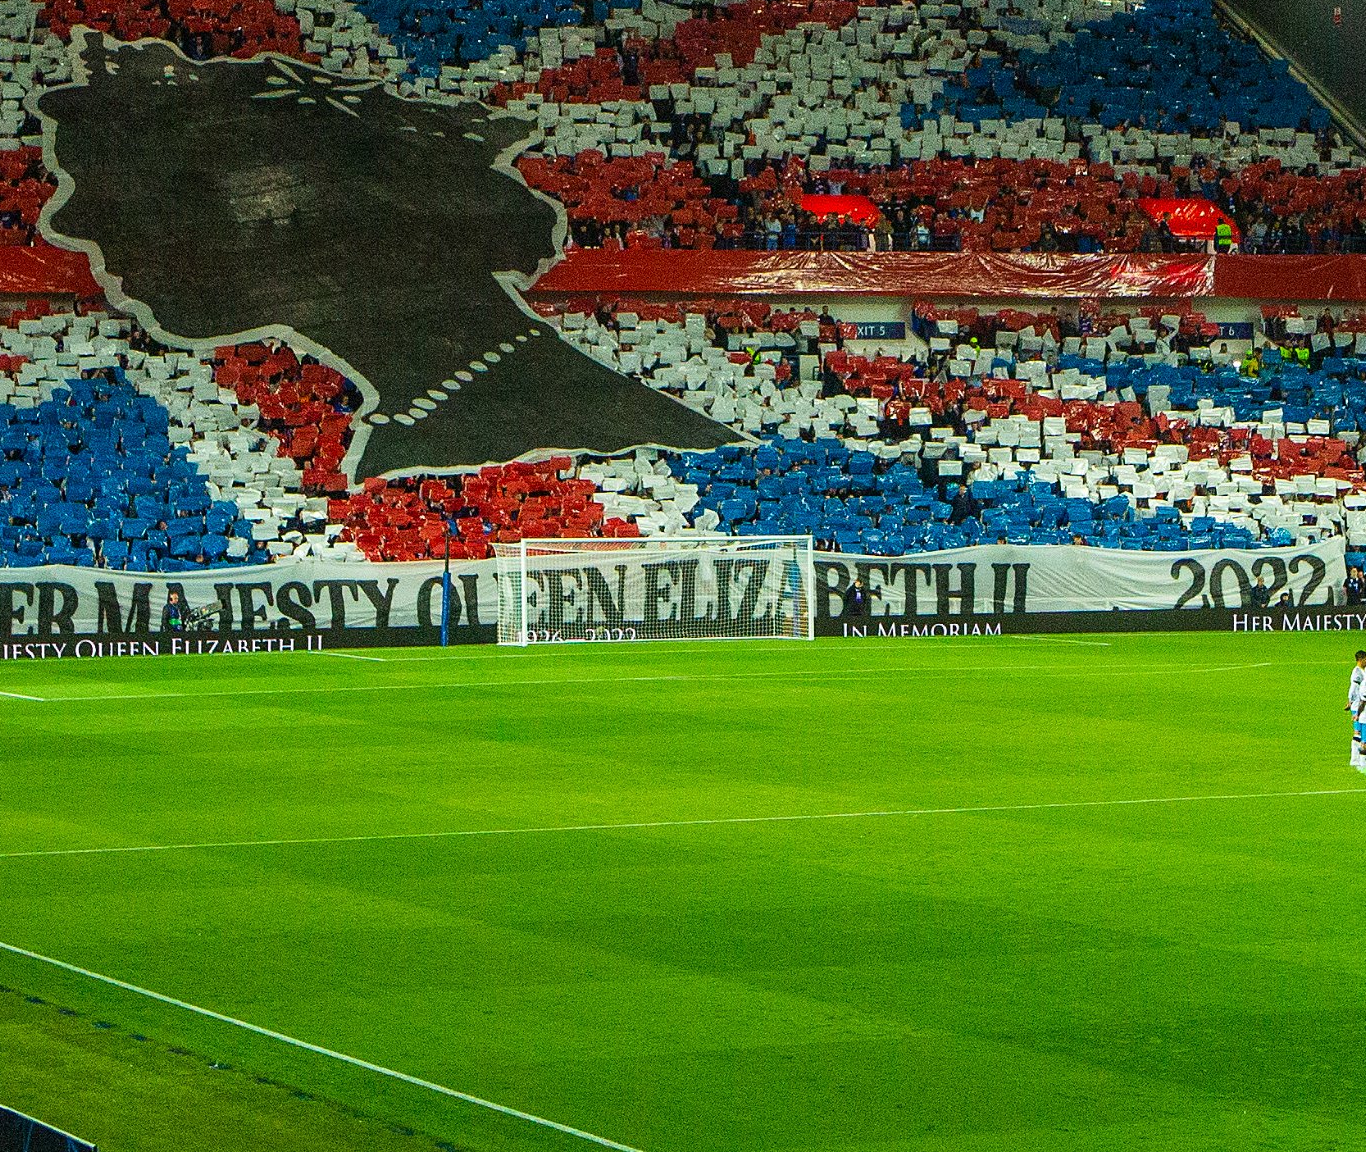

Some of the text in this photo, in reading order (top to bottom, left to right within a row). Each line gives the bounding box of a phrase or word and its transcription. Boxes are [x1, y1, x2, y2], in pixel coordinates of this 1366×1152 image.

[857, 325, 886, 336] XIT 5
[1228, 327, 1235, 336] 6
[1170, 554, 1335, 609] 2022
[94, 577, 400, 635] MAJESTY
[640, 558, 977, 625] ELIZABETH
[990, 562, 1031, 614] II
[843, 622, 1003, 638] IN MEMORIAM
[1233, 613, 1274, 632] HER
[75, 639, 160, 659] QUEEN
[171, 636, 296, 656] ELIZABETH
[306, 634, 324, 652] II
